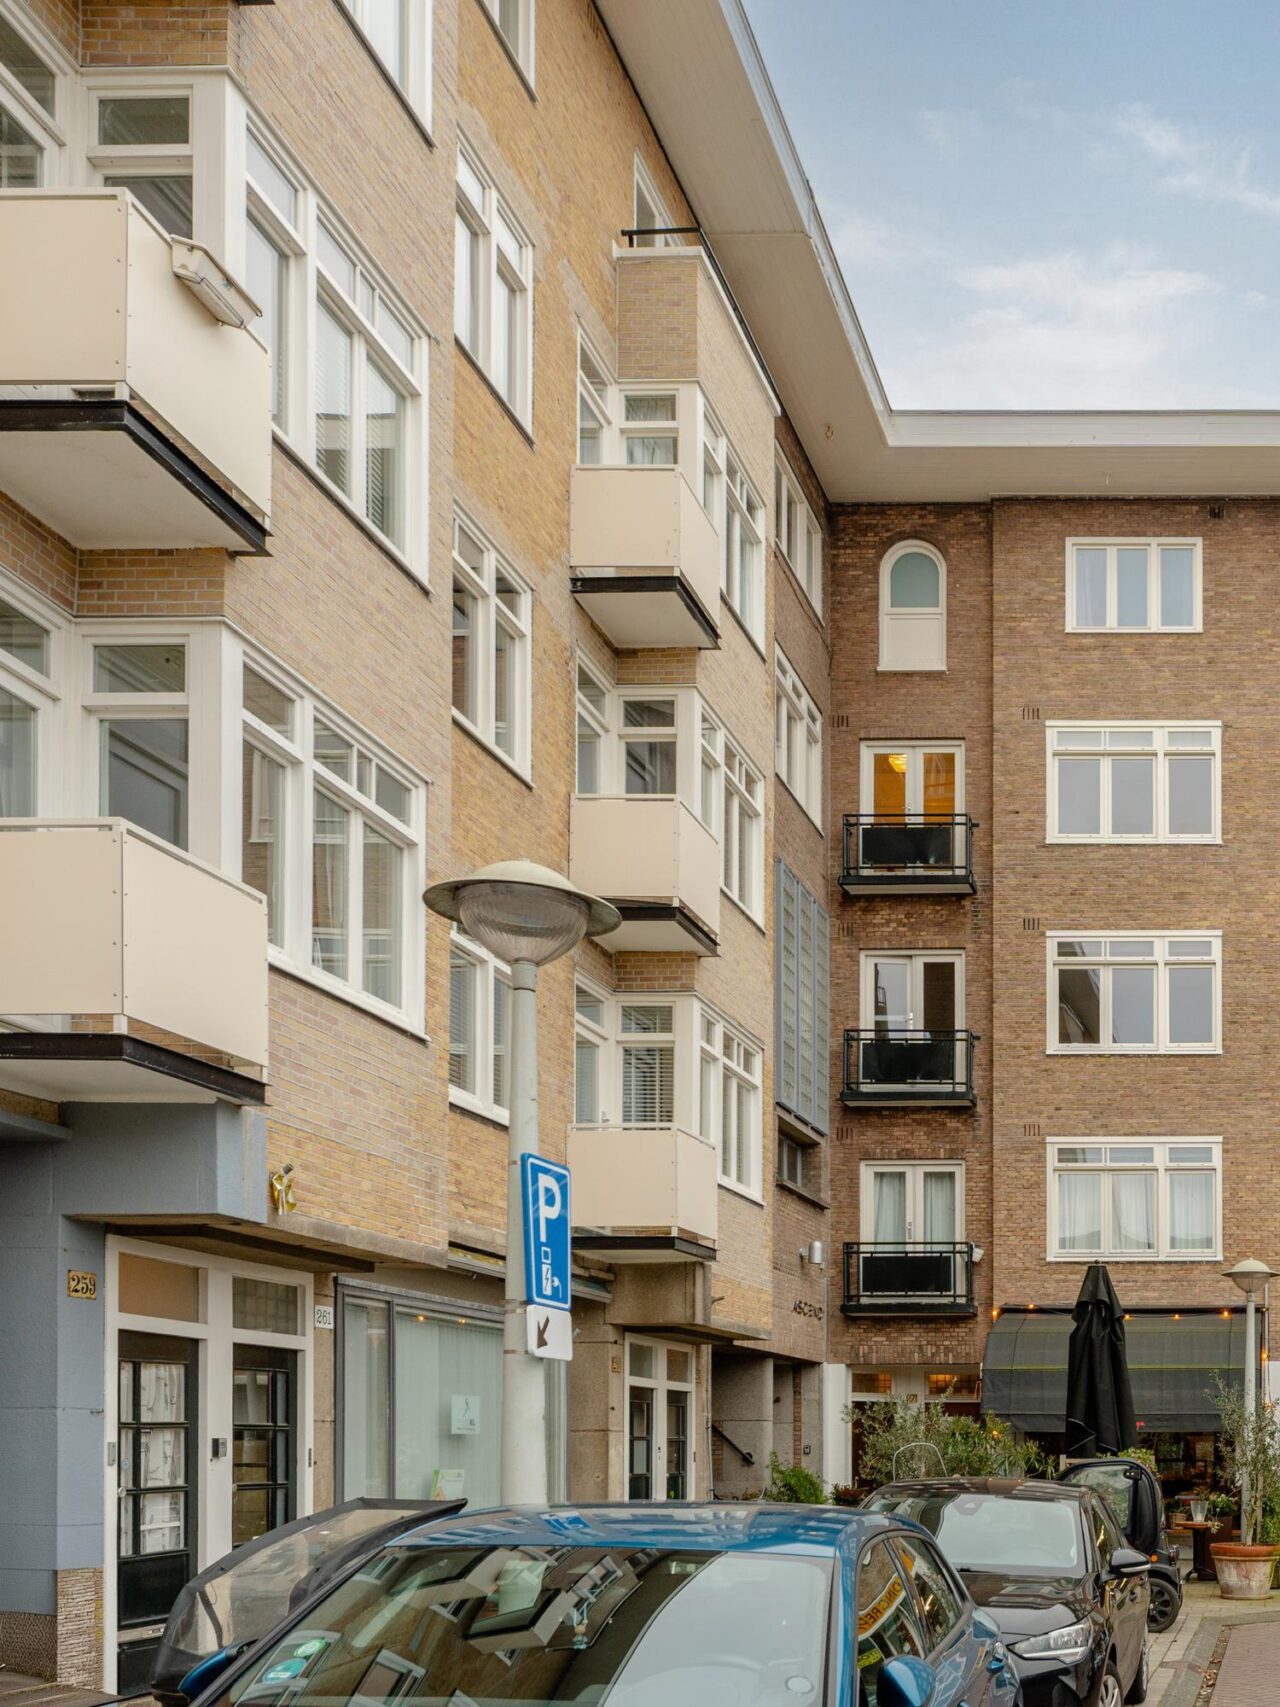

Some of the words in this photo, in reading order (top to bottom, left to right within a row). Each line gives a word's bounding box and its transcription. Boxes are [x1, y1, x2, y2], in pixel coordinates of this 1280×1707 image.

[538, 1172, 562, 1243] P
[71, 1274, 96, 1296] 259
[316, 1309, 332, 1325] 261
